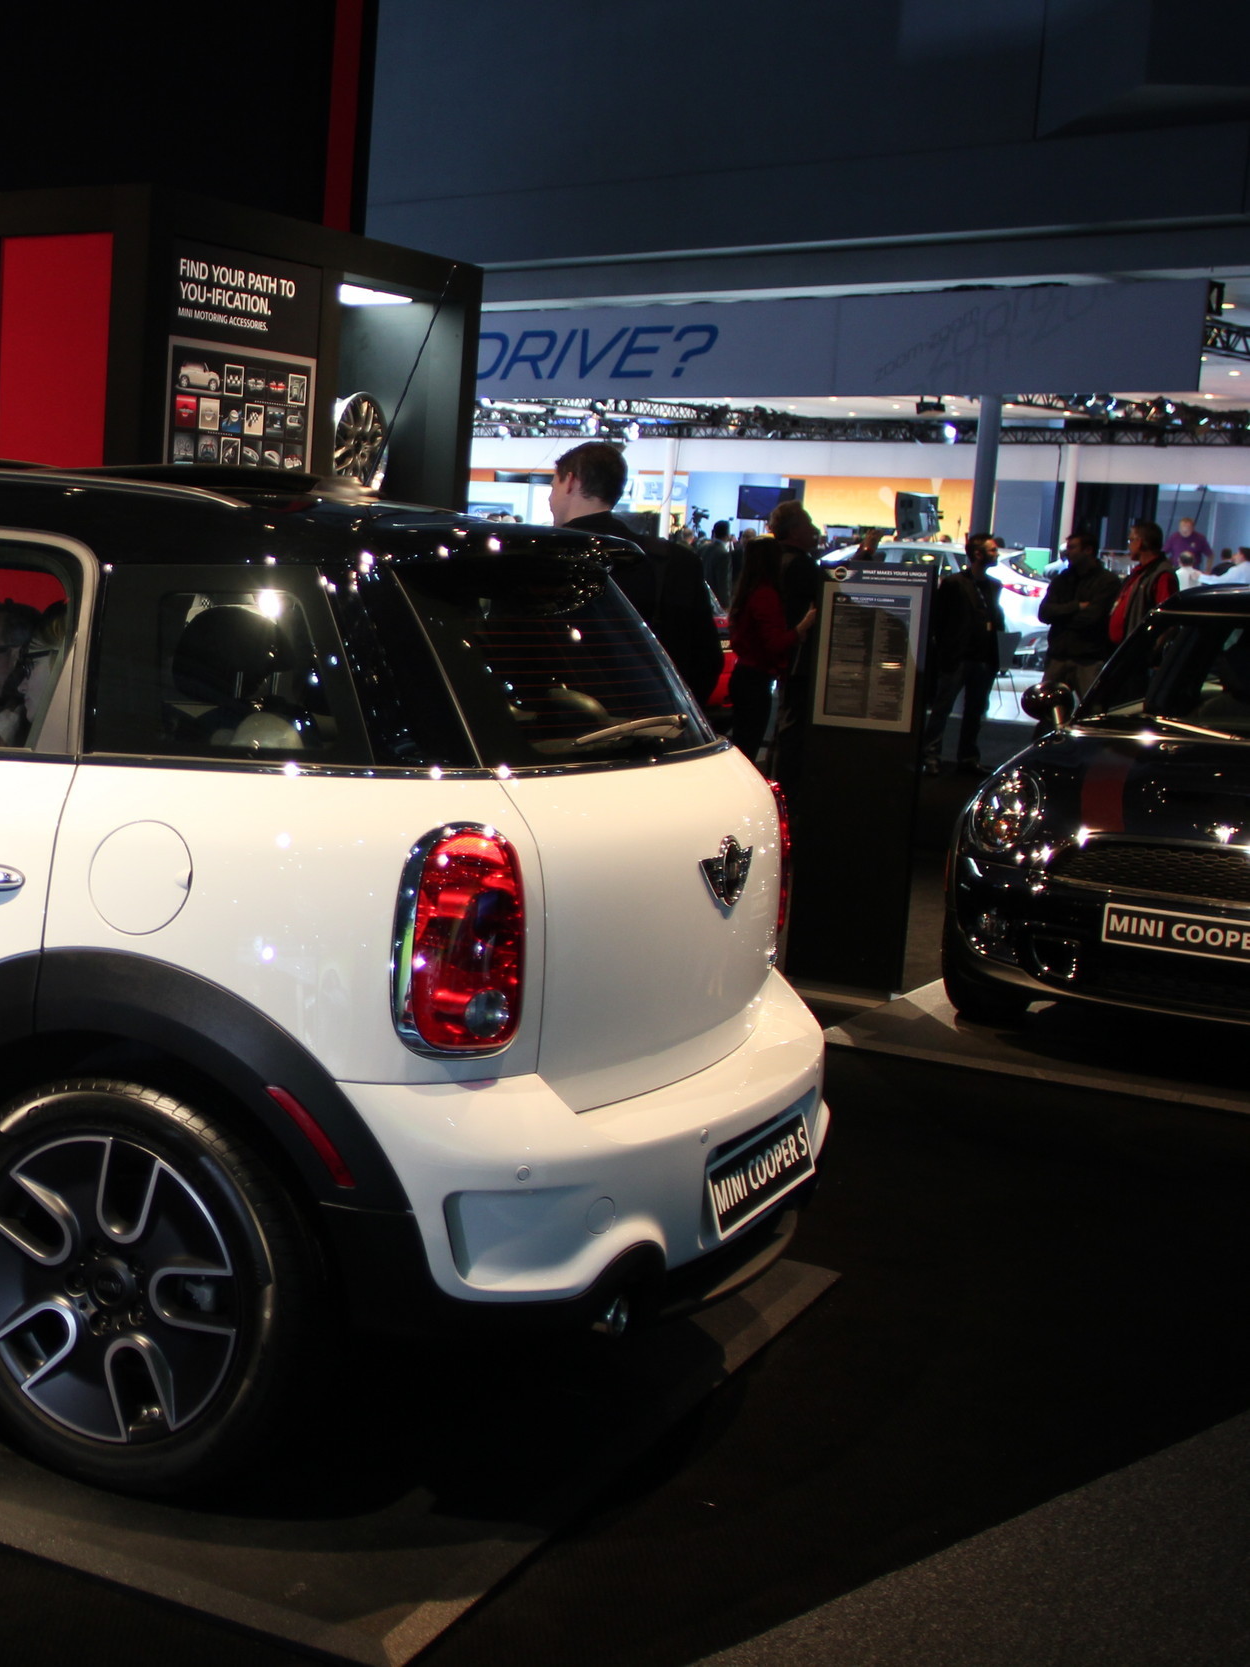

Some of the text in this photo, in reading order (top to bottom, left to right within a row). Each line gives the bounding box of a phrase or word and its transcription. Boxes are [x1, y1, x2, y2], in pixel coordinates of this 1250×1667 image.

[180, 258, 296, 298] FIND YOUR PATH TO
[180, 281, 271, 315] YOU-IFICATION.
[178, 306, 268, 331] MINI MOTORING ACCESSORIES.
[476, 324, 719, 380] DRIVE?
[1109, 914, 1164, 938] MINI
[714, 1126, 808, 1215] MINI COOPER S
